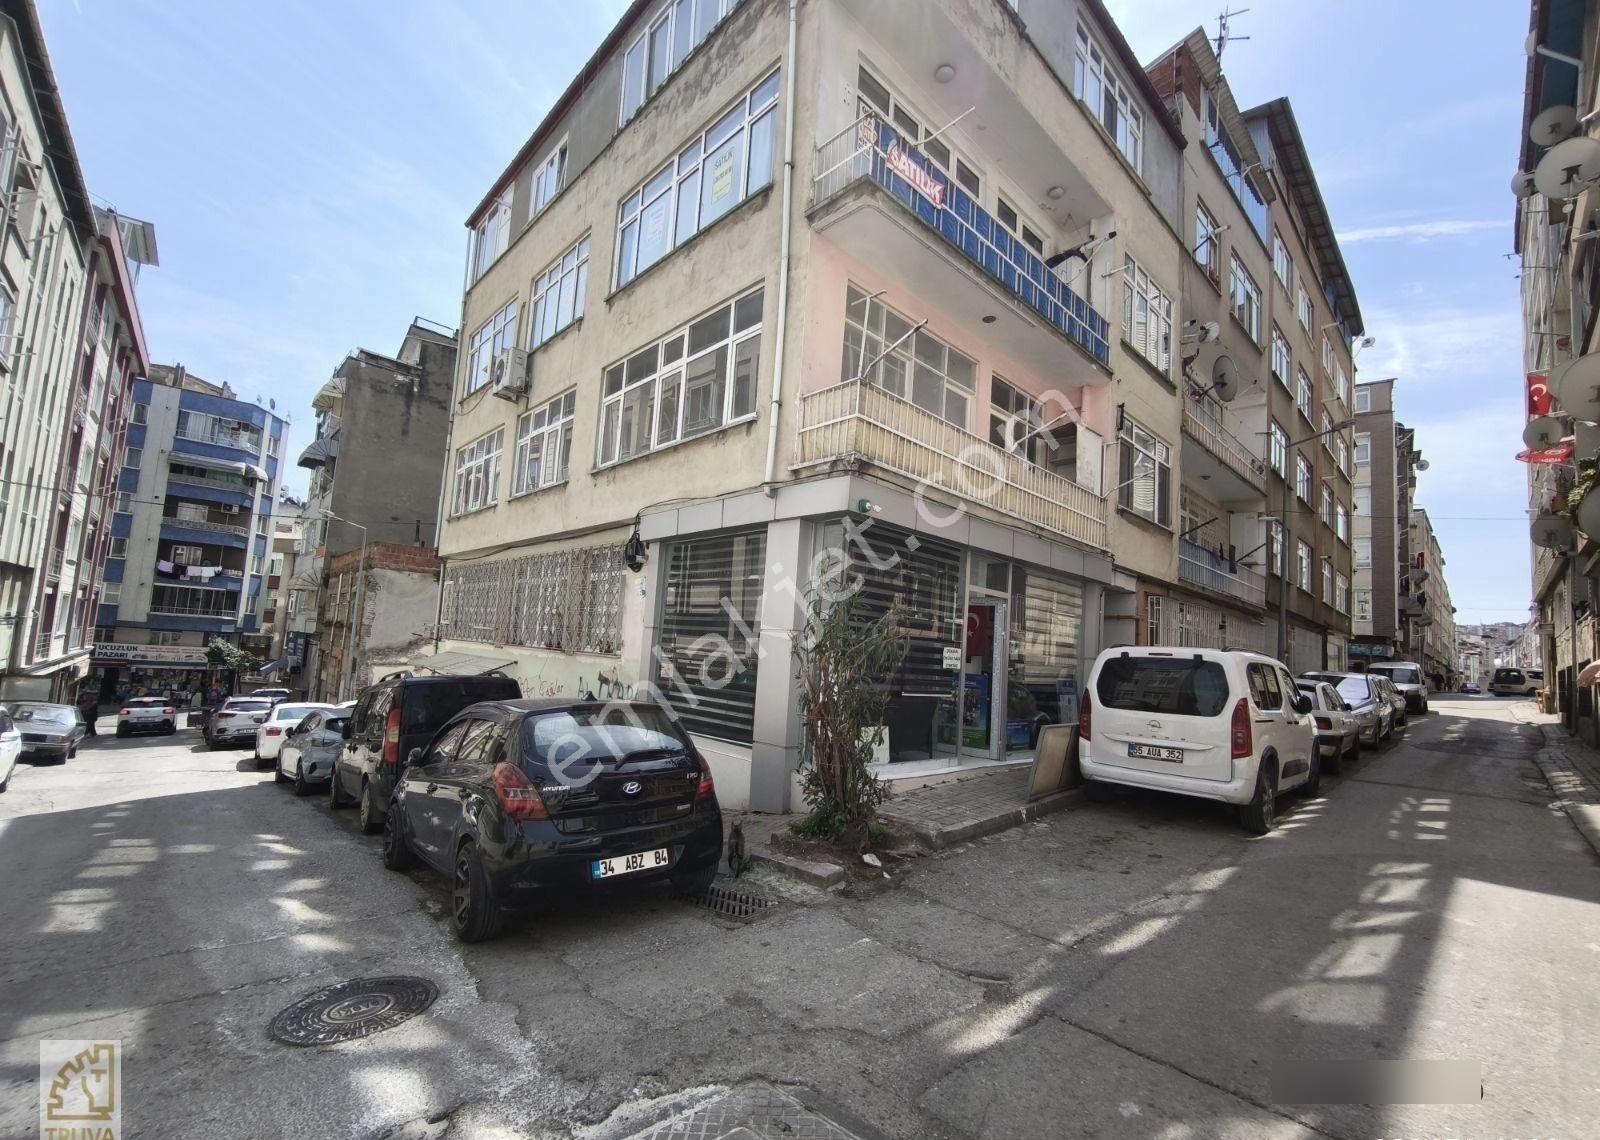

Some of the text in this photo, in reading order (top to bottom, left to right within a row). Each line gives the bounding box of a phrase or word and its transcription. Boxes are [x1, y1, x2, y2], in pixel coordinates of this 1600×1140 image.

[889, 146, 943, 205] SATILIK
[98, 644, 138, 652] UCUZLUK
[97, 651, 128, 659] PAZARI
[1147, 748, 1161, 757] AUA
[1165, 750, 1182, 760] 352
[601, 850, 667, 876] 34 ABZ 84
